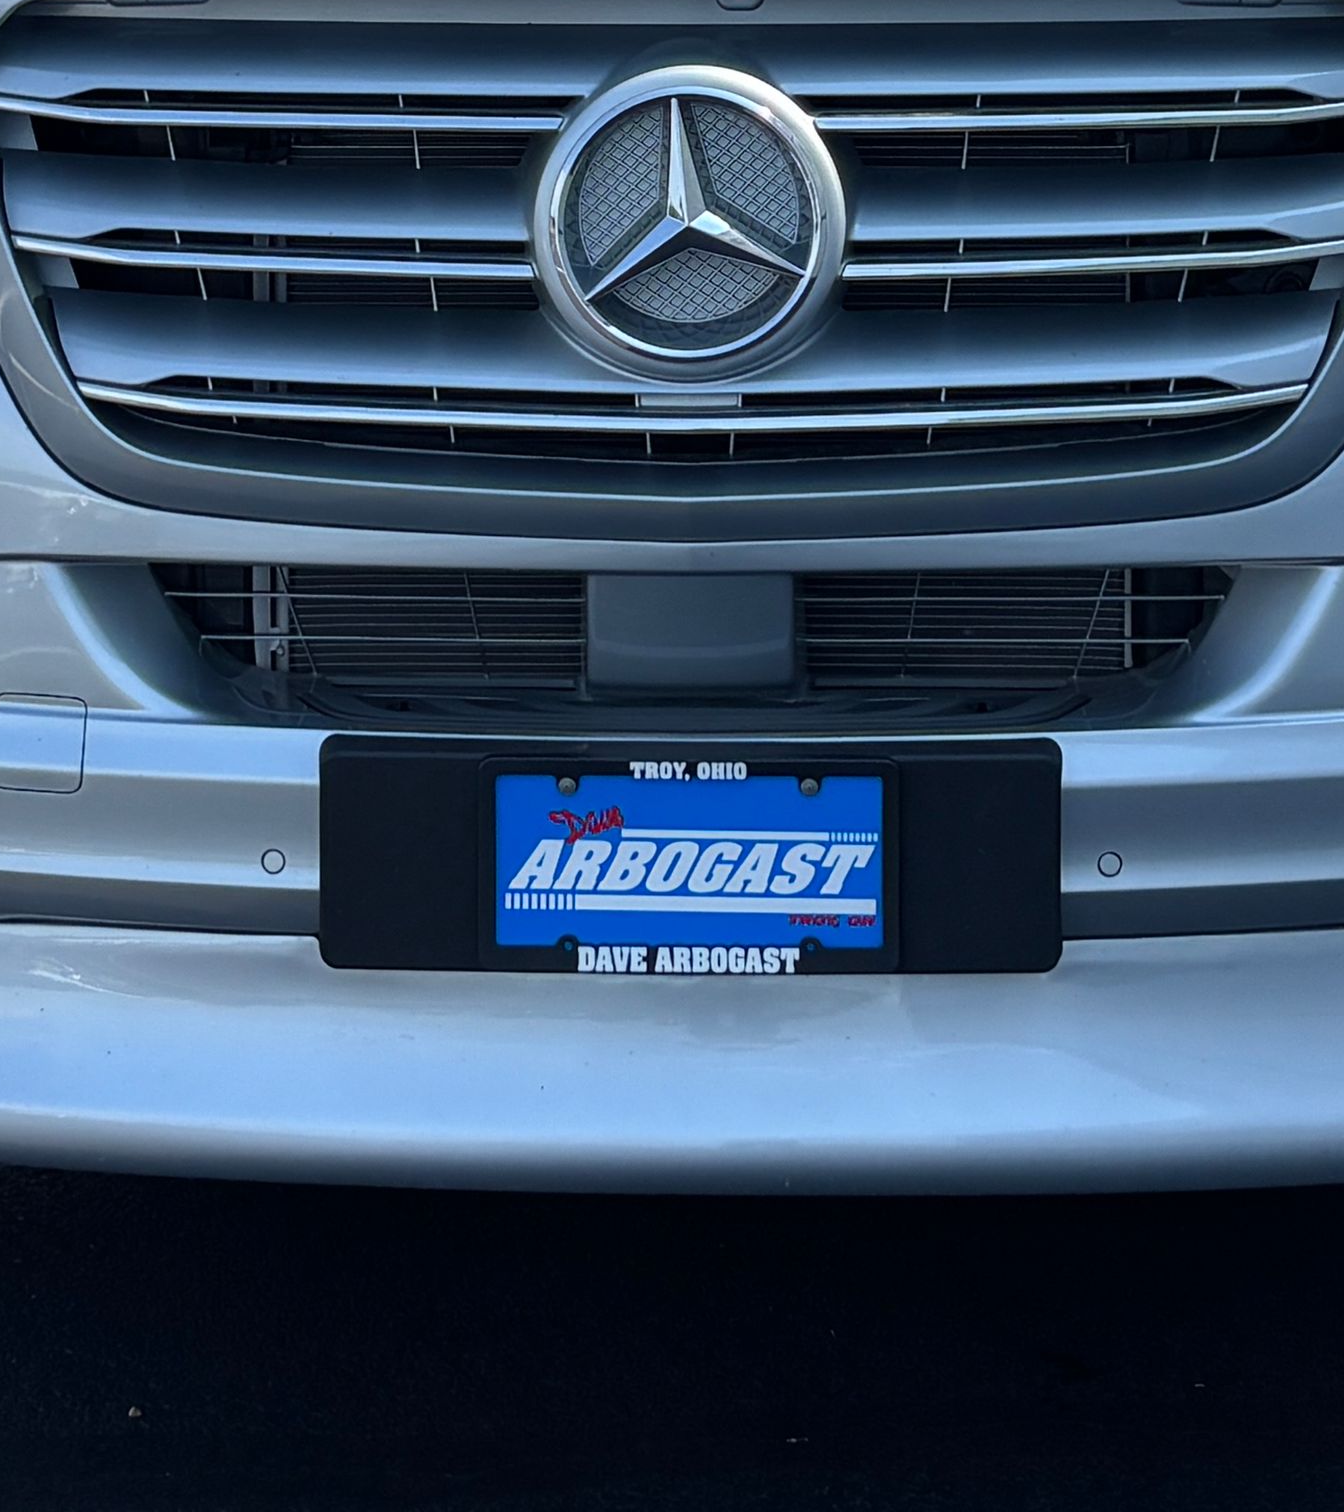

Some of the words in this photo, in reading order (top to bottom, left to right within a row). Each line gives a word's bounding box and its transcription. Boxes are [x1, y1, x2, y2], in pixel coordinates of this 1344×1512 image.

[629, 760, 691, 782] TROY,
[696, 761, 748, 781] OHIO
[508, 838, 877, 895] ARBOGAST
[577, 945, 648, 973] DAVE
[654, 946, 801, 974] ARBOGAST
